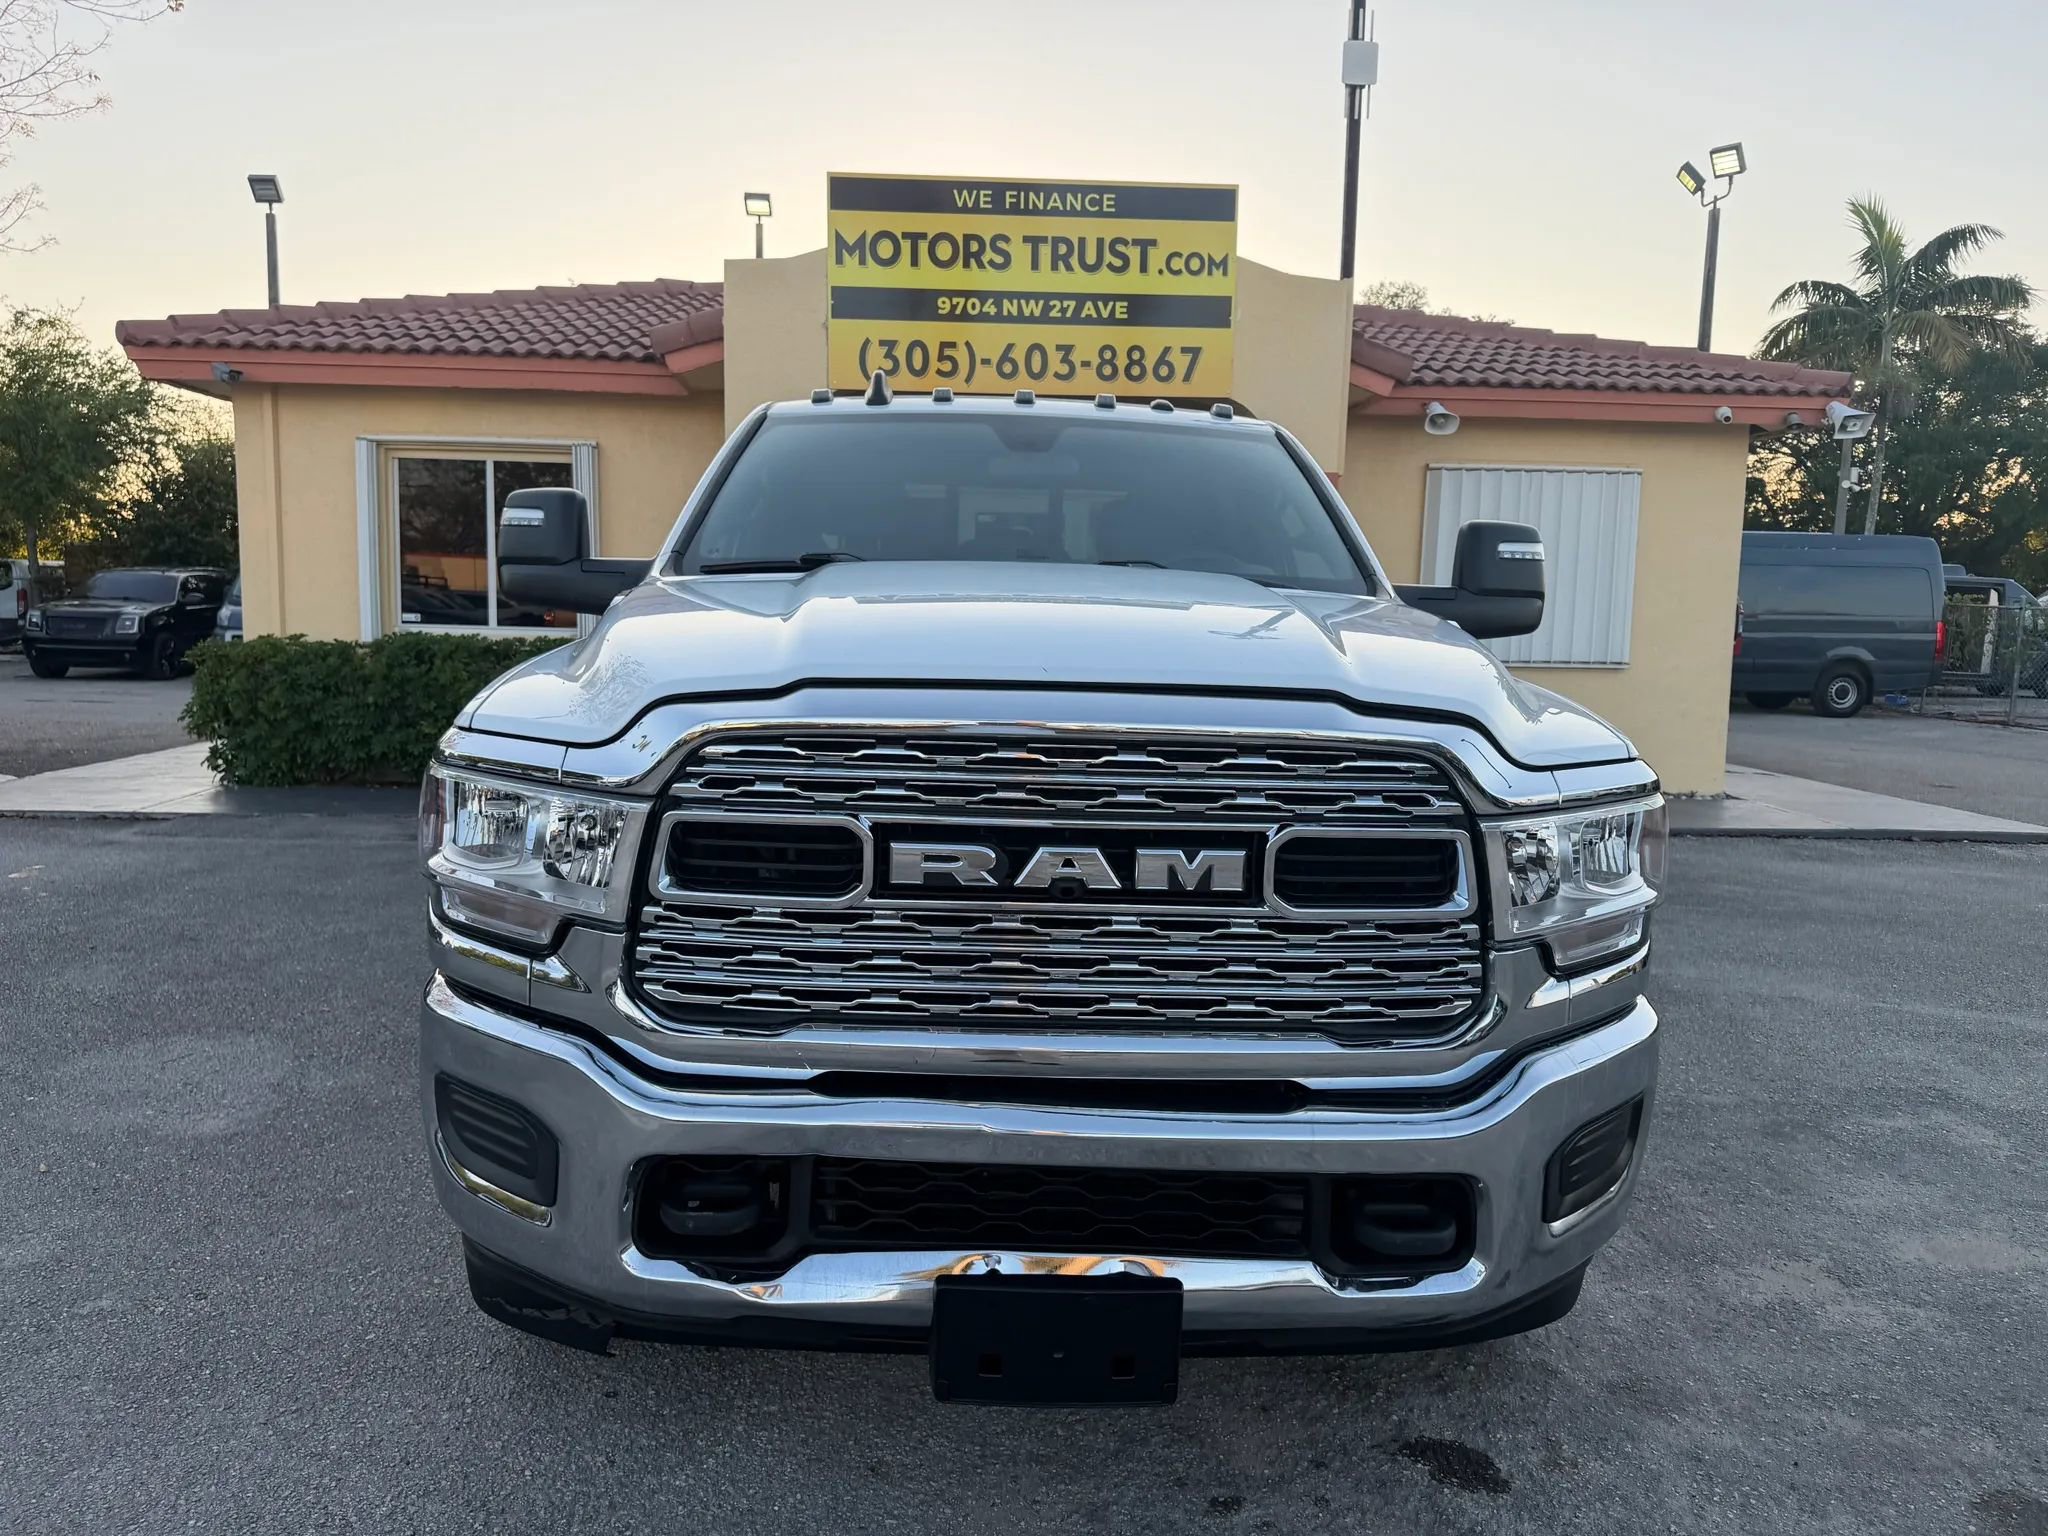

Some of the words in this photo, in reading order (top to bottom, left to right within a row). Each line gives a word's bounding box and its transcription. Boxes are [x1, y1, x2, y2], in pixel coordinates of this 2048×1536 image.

[953, 189, 993, 209] WE
[1005, 191, 1117, 212] FINANCE
[834, 228, 1012, 272] MOTORS
[936, 297, 998, 315] 9704
[1002, 299, 1044, 317] NW
[1048, 300, 1077, 318] 27
[1080, 301, 1129, 319] AVE
[858, 337, 1203, 385] (305)-603-8867
[889, 842, 1247, 891] RAM
